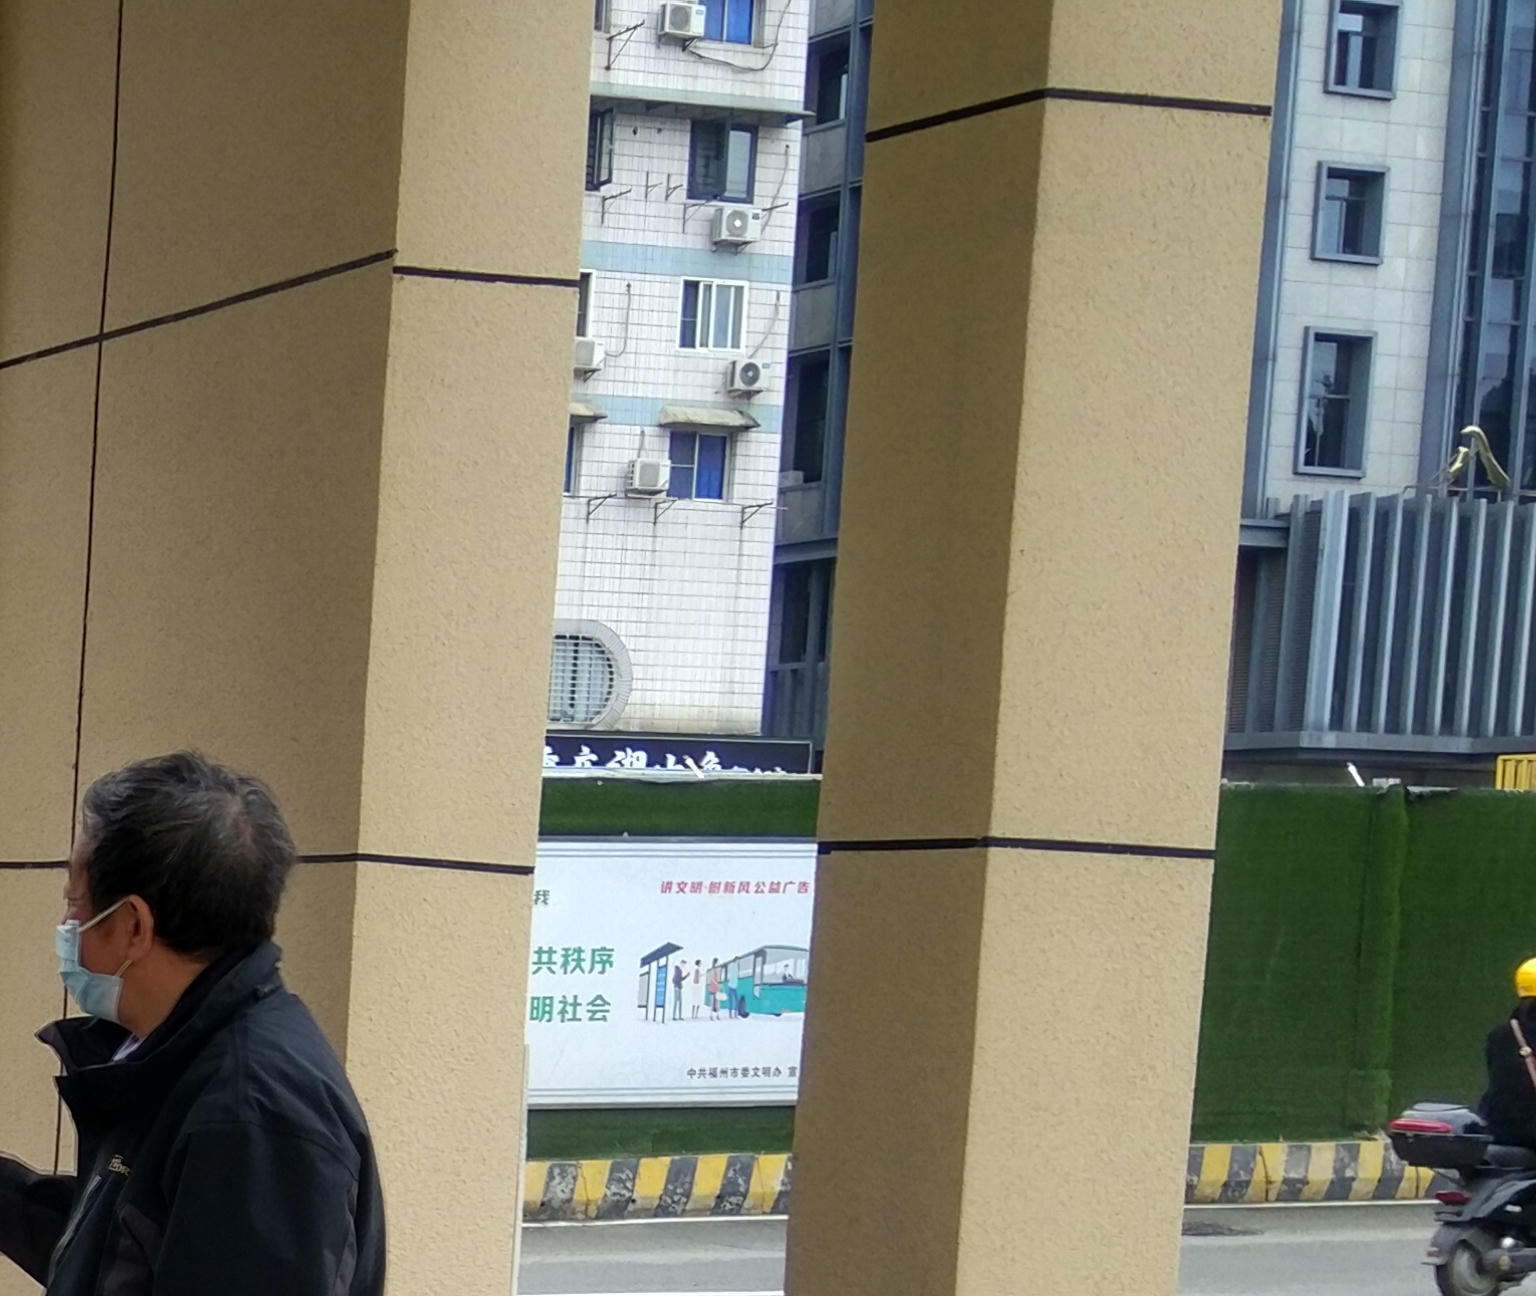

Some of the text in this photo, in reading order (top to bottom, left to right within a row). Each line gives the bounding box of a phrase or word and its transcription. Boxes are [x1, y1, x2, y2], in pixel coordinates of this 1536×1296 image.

[531, 945, 616, 976] 共秩序
[529, 993, 612, 1024] 明社会
[686, 1066, 782, 1079] 中共福州市委文明办
